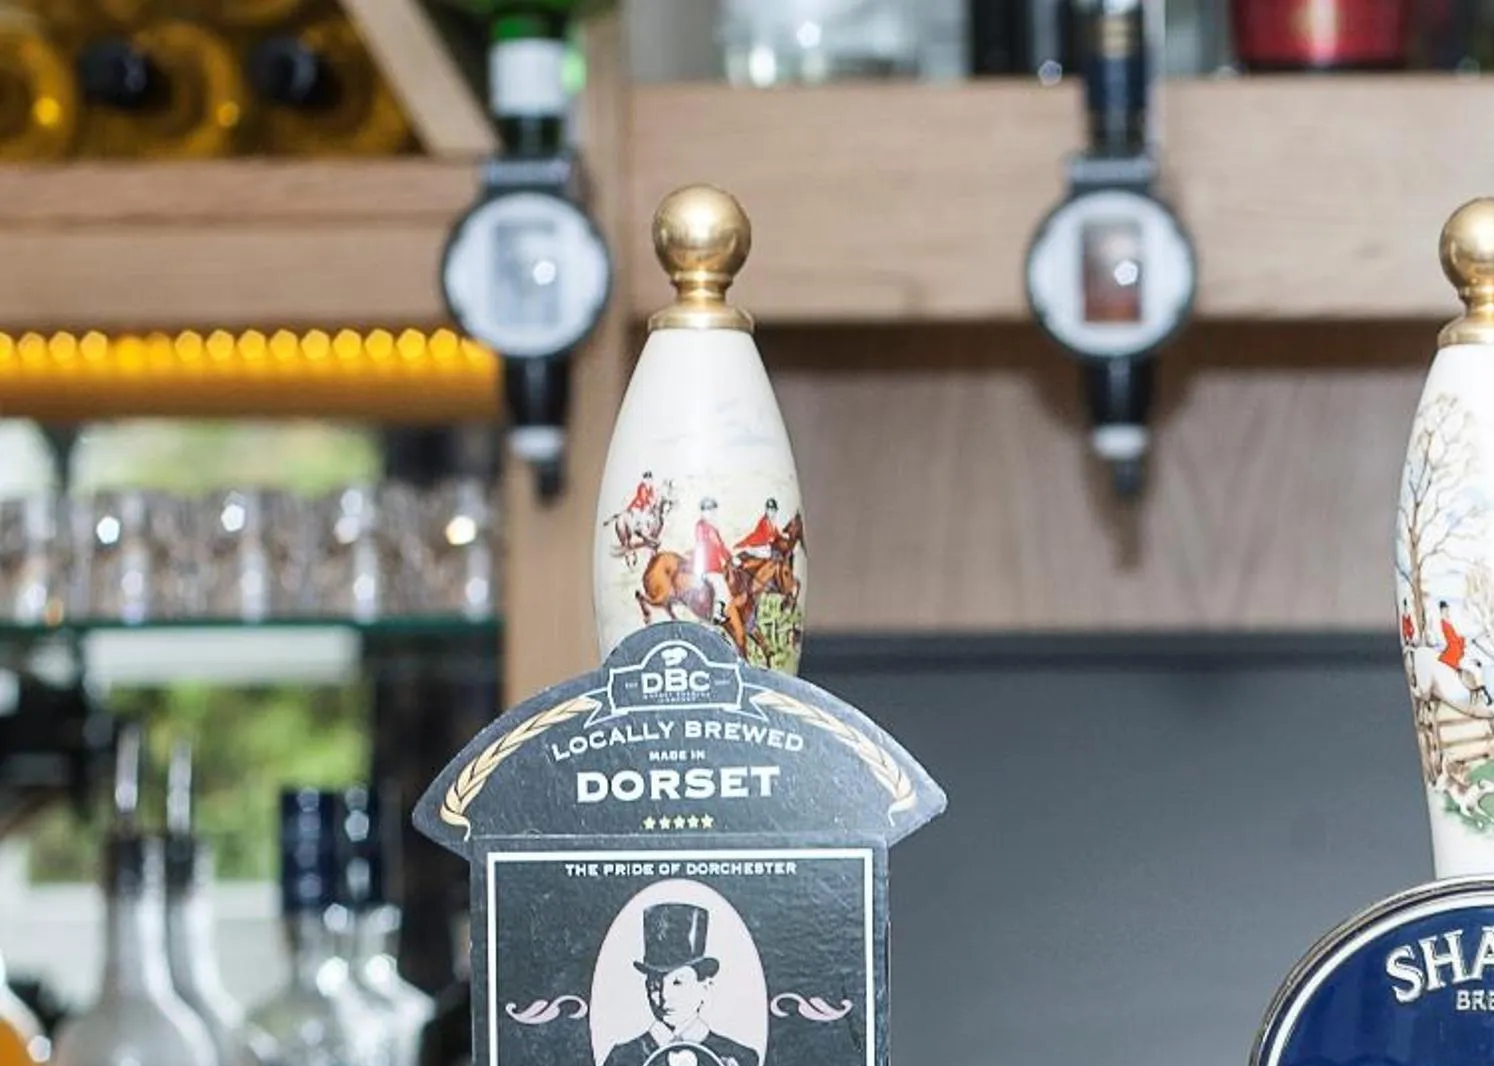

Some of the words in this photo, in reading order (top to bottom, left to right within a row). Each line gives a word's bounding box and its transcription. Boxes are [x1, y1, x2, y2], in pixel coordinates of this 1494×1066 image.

[641, 668, 711, 694] DBC
[552, 721, 675, 761] LOCALLY
[685, 720, 804, 752] BREWED
[649, 751, 687, 761] MADE
[691, 750, 706, 760] IN
[576, 766, 781, 803] DORSET
[565, 863, 599, 876] THE
[603, 863, 655, 876] PRIDE
[659, 863, 681, 875] OF
[686, 862, 798, 876] DORCHESTER
